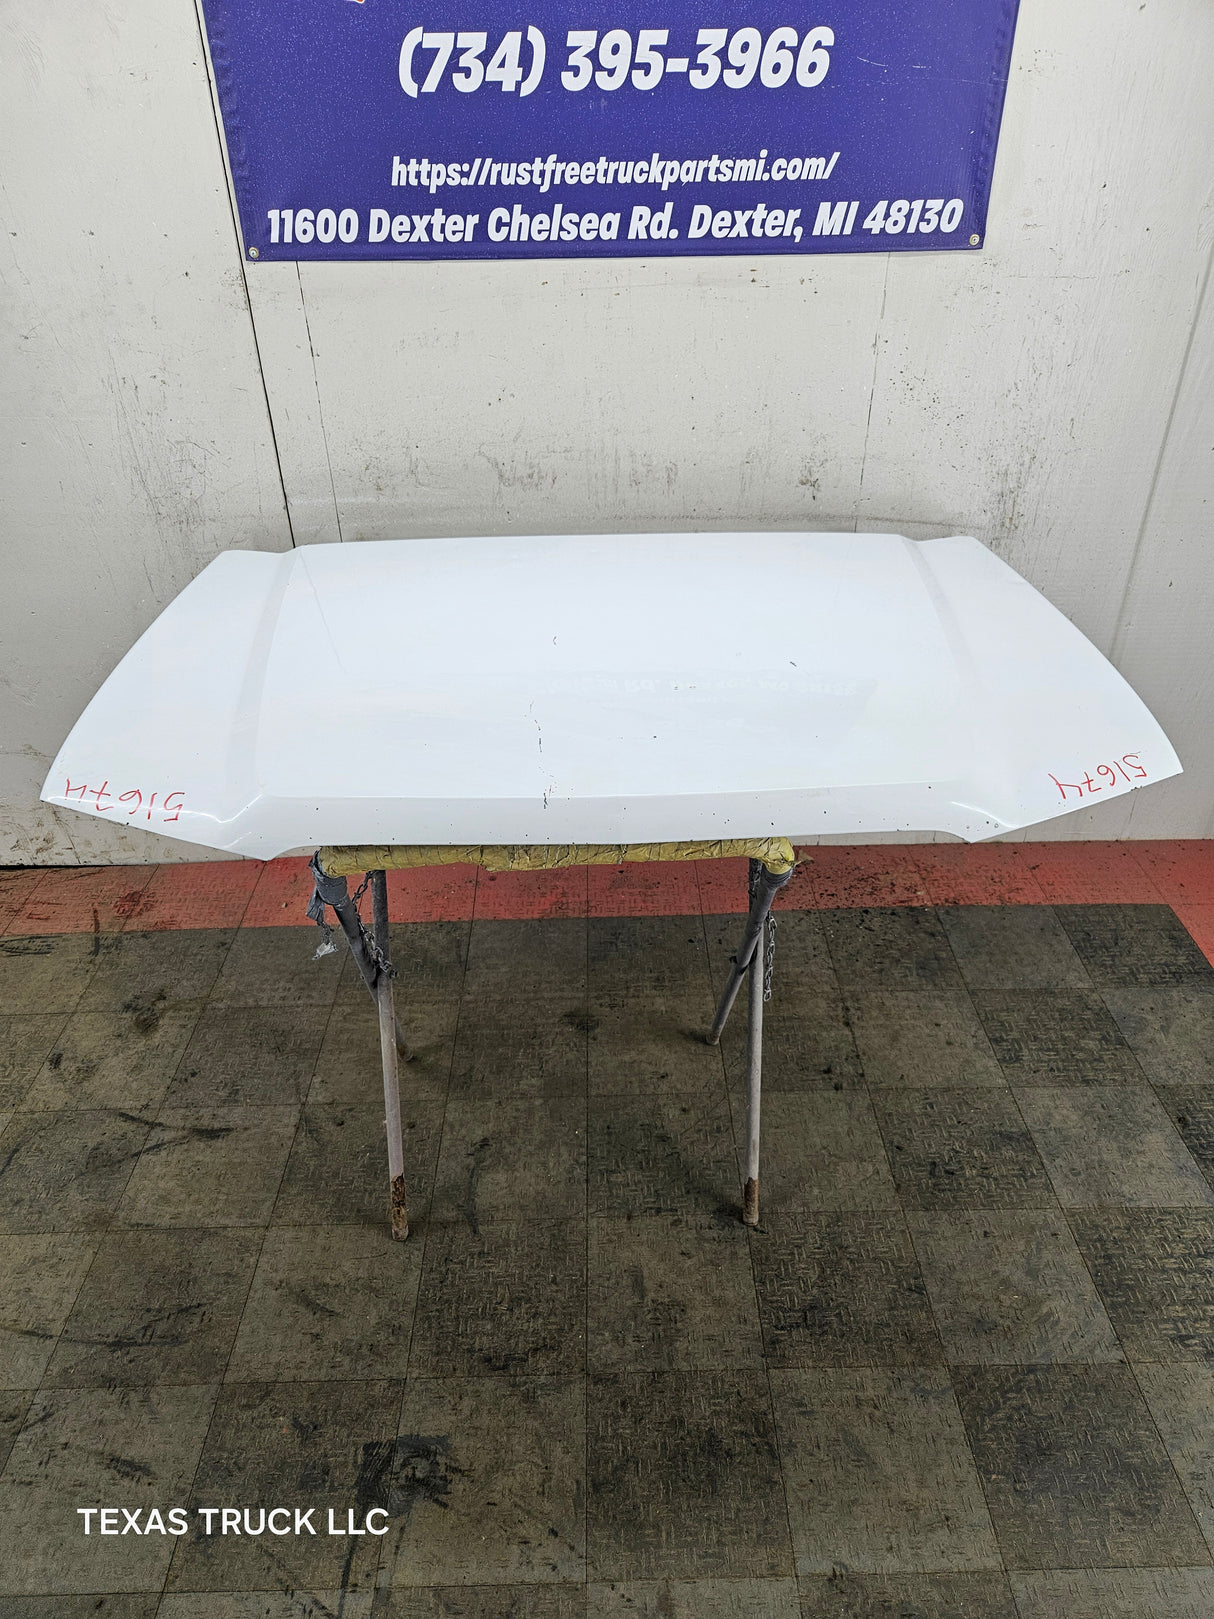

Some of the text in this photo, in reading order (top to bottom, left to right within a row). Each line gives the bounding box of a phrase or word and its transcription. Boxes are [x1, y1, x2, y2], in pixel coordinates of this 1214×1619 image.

[398, 25, 835, 98] (734) 395-3966
[391, 149, 840, 194] https://rustfreetruckpartsmi.com/
[267, 198, 964, 244] 11600 Dexter Chelsea Rd. Dexter, MI 48130
